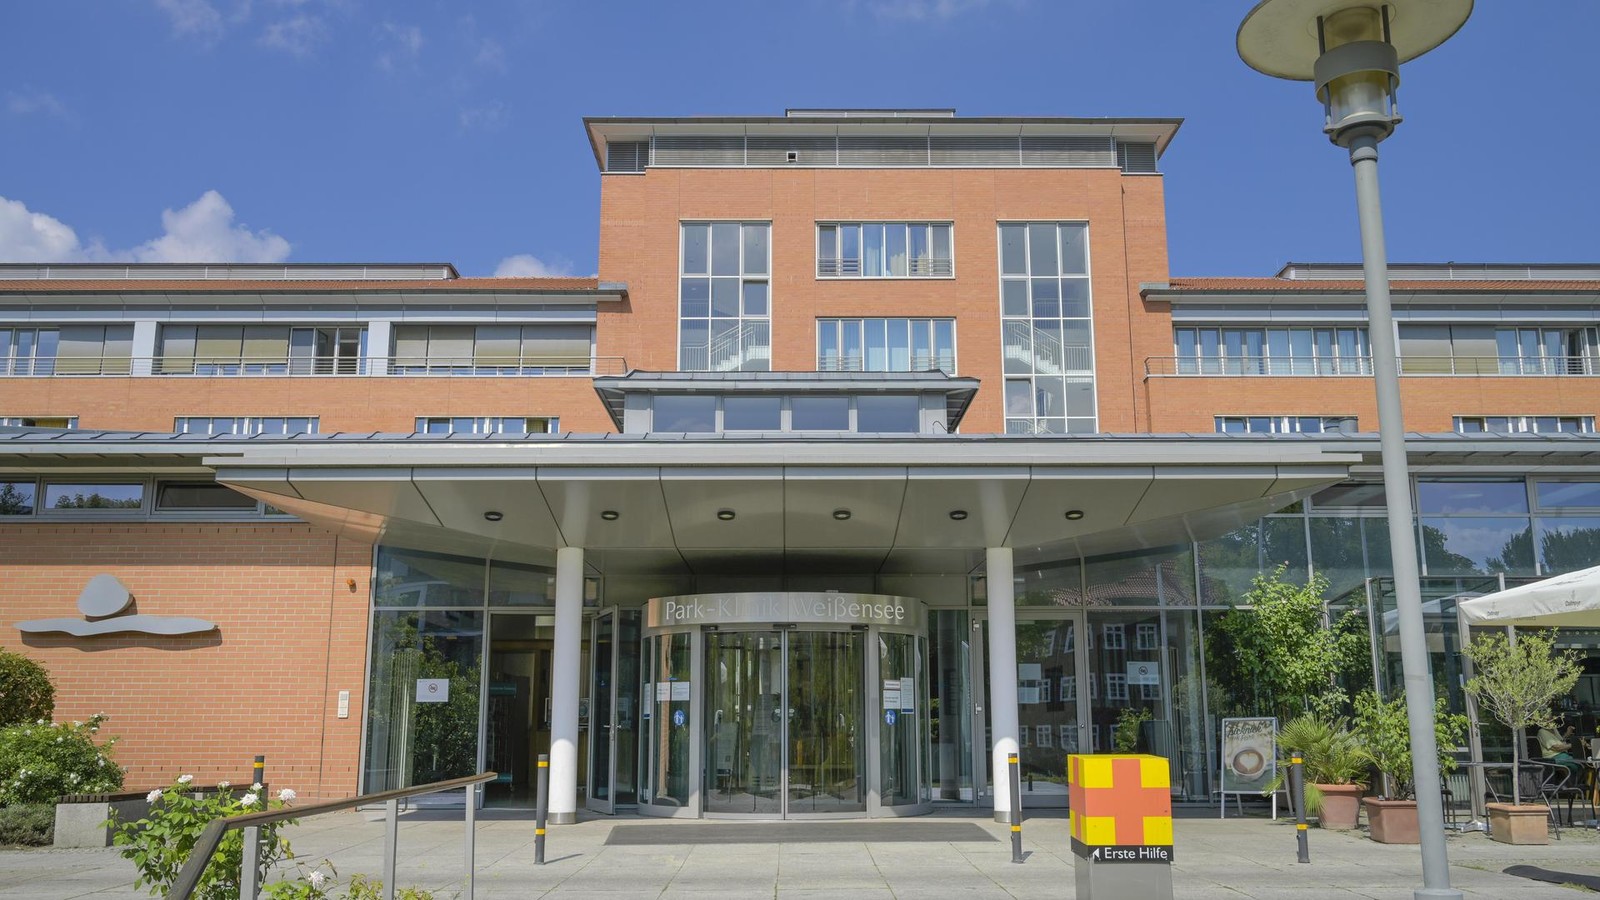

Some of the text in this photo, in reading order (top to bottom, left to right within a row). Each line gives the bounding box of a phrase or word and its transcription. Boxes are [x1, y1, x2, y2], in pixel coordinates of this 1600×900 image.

[791, 596, 905, 621] Weißensee
[1104, 847, 1168, 859] Erste Hilfe
